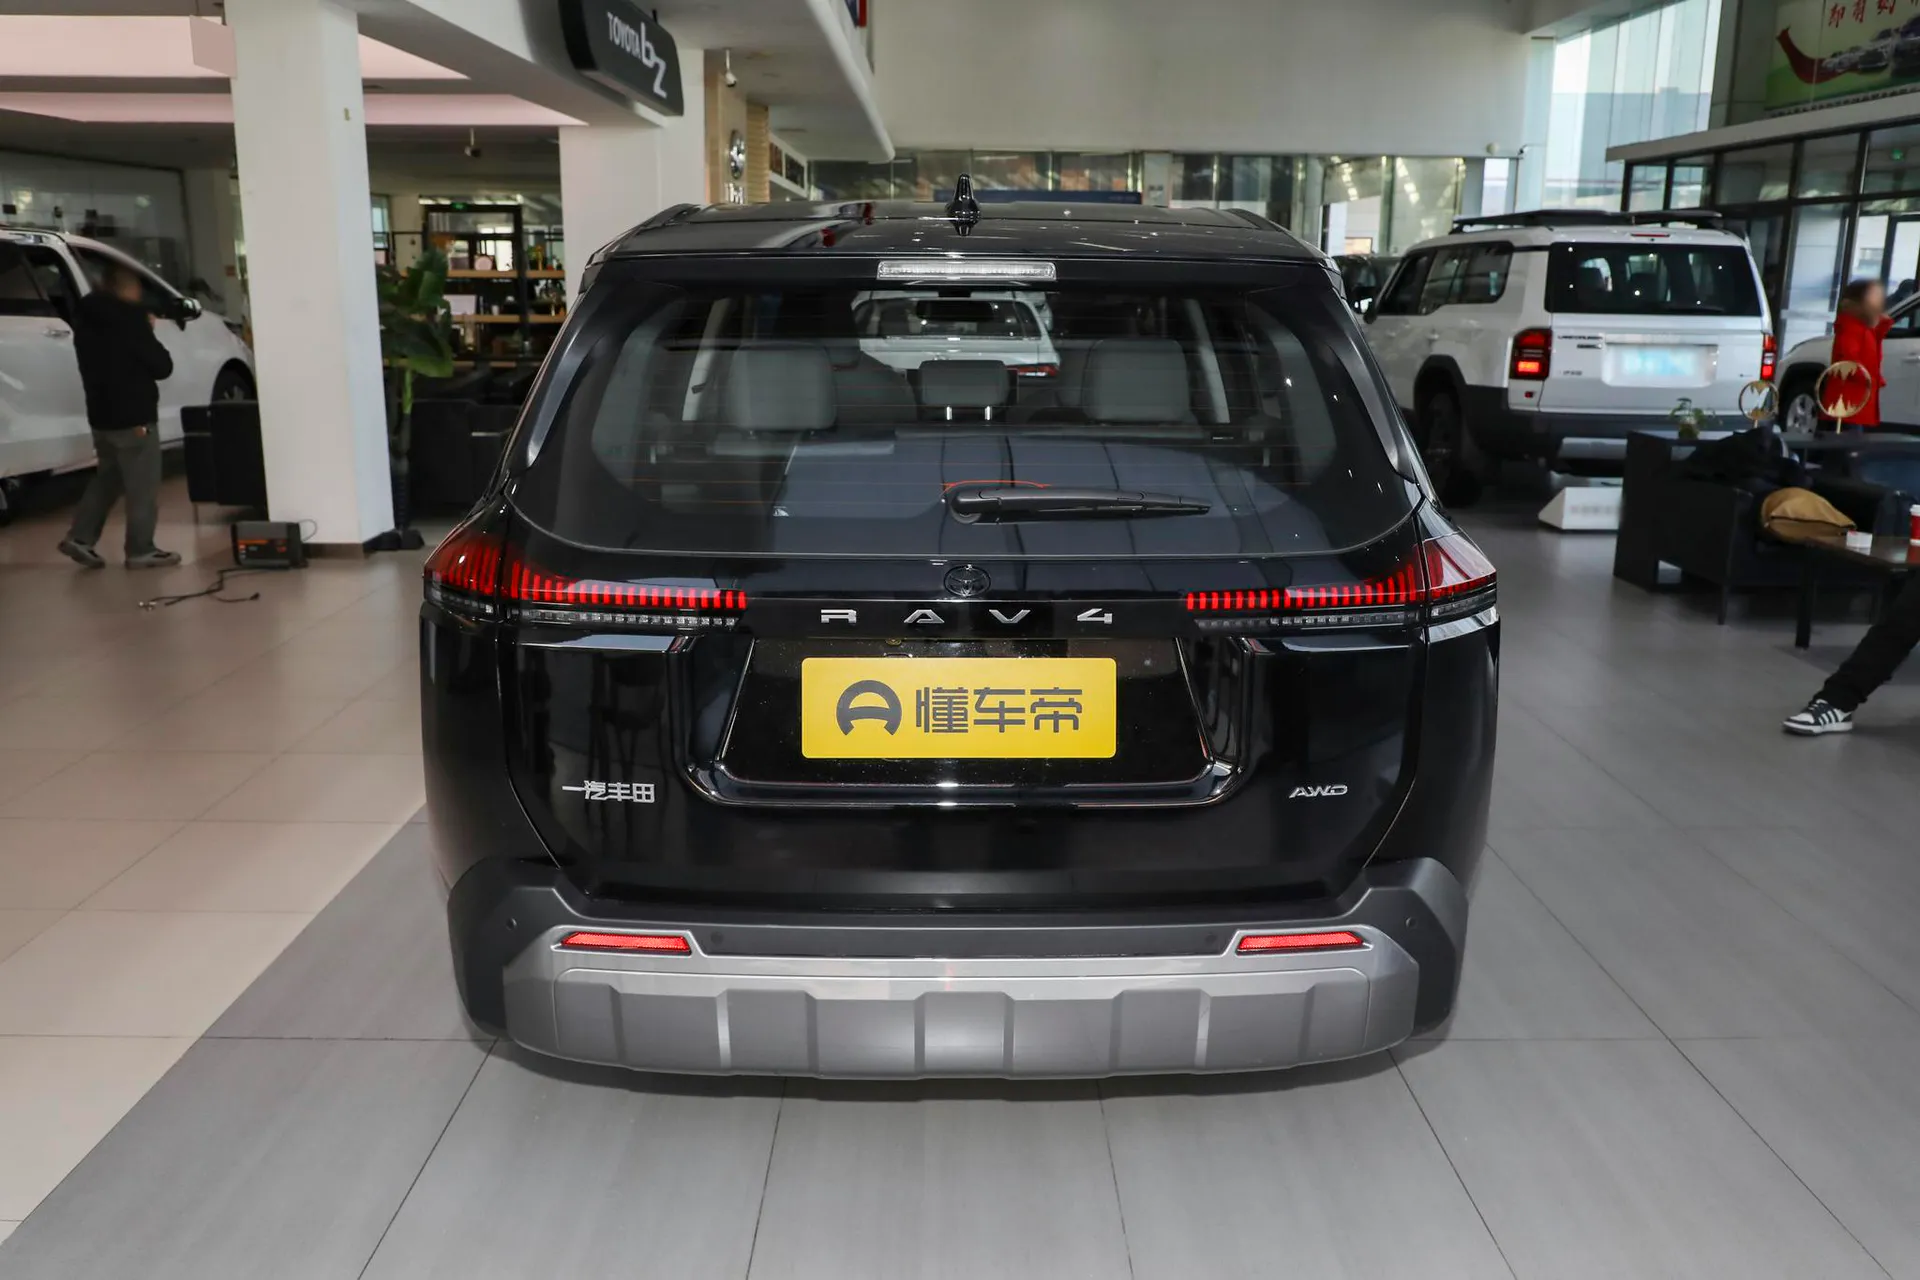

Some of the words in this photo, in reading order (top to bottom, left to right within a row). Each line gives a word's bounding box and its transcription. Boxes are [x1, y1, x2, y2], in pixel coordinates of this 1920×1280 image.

[607, 11, 642, 60] TOYOTA
[820, 608, 1113, 625] RAV4
[915, 687, 1083, 733] 懂车帝
[562, 780, 655, 803] 一汽丰田
[1289, 784, 1348, 798] AWD
